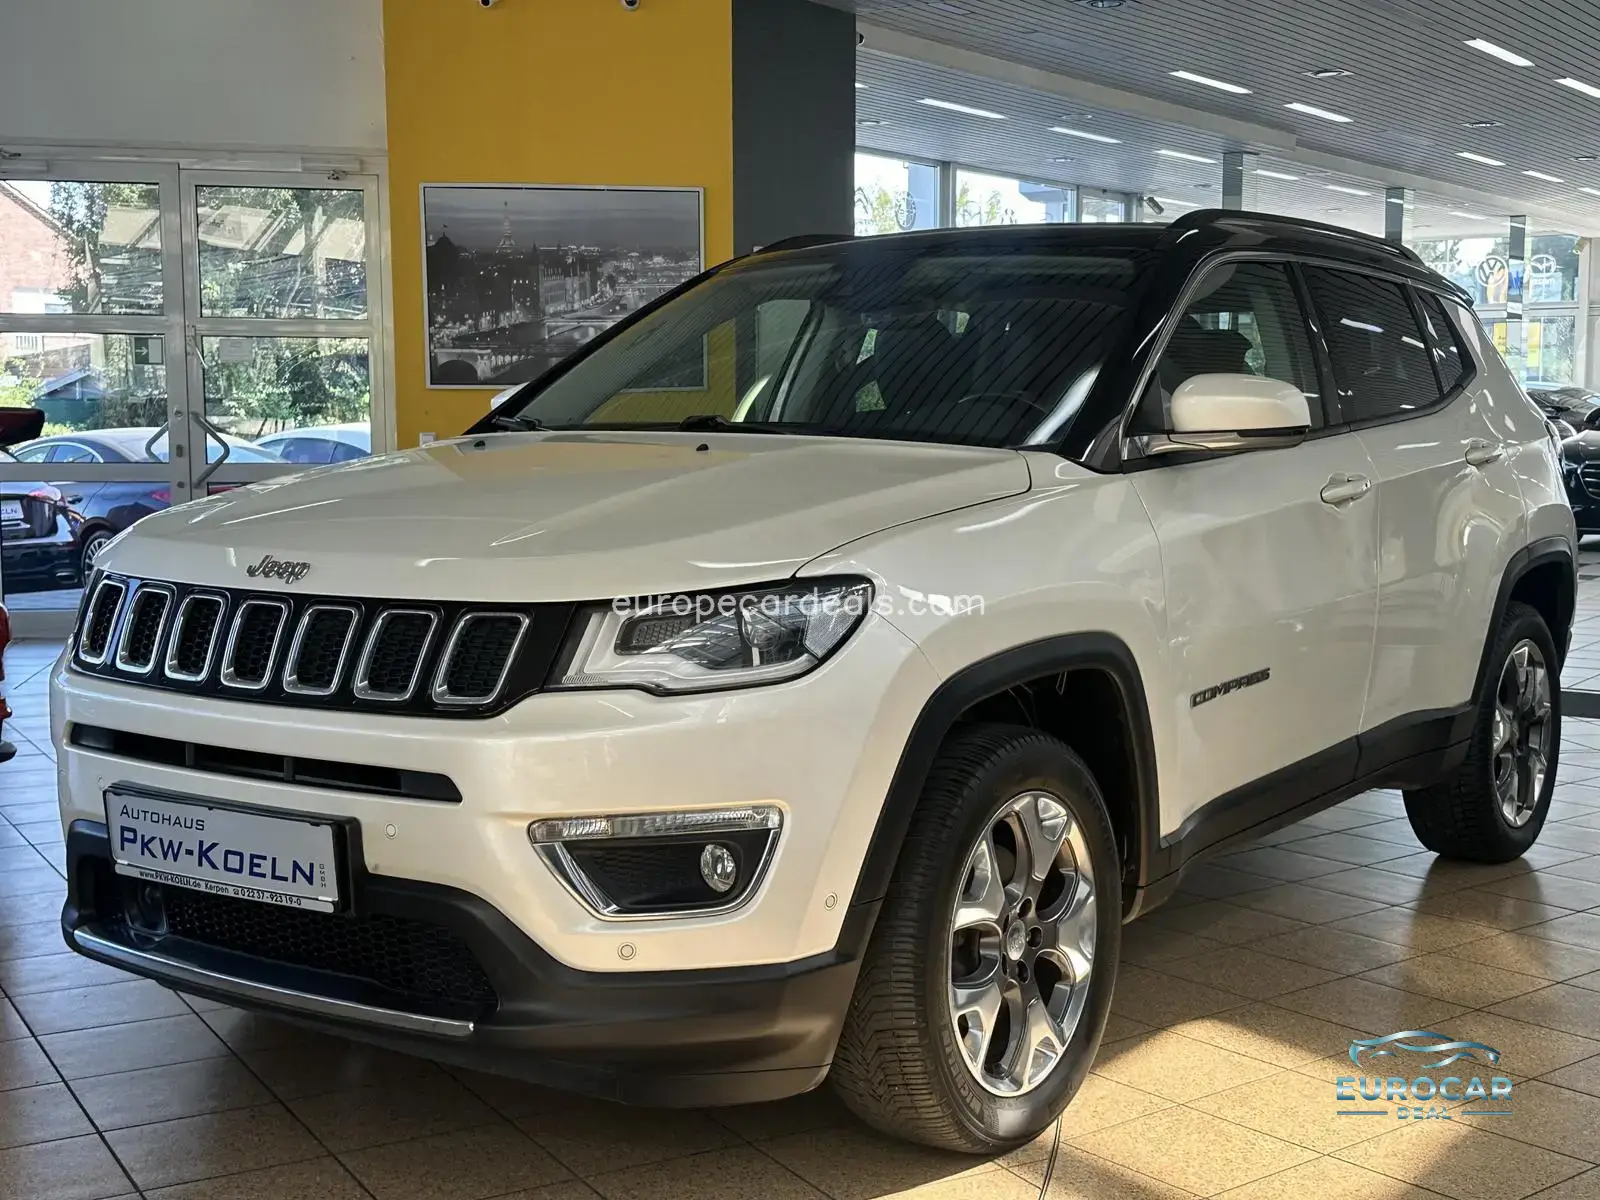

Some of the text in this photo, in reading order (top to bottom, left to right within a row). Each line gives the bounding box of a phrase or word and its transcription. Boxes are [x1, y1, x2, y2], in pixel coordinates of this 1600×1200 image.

[246, 554, 311, 584] Jeep
[119, 804, 205, 831] AUTOHAUS
[119, 825, 315, 886] PKW-KOELN
[204, 882, 229, 894] Kerpen
